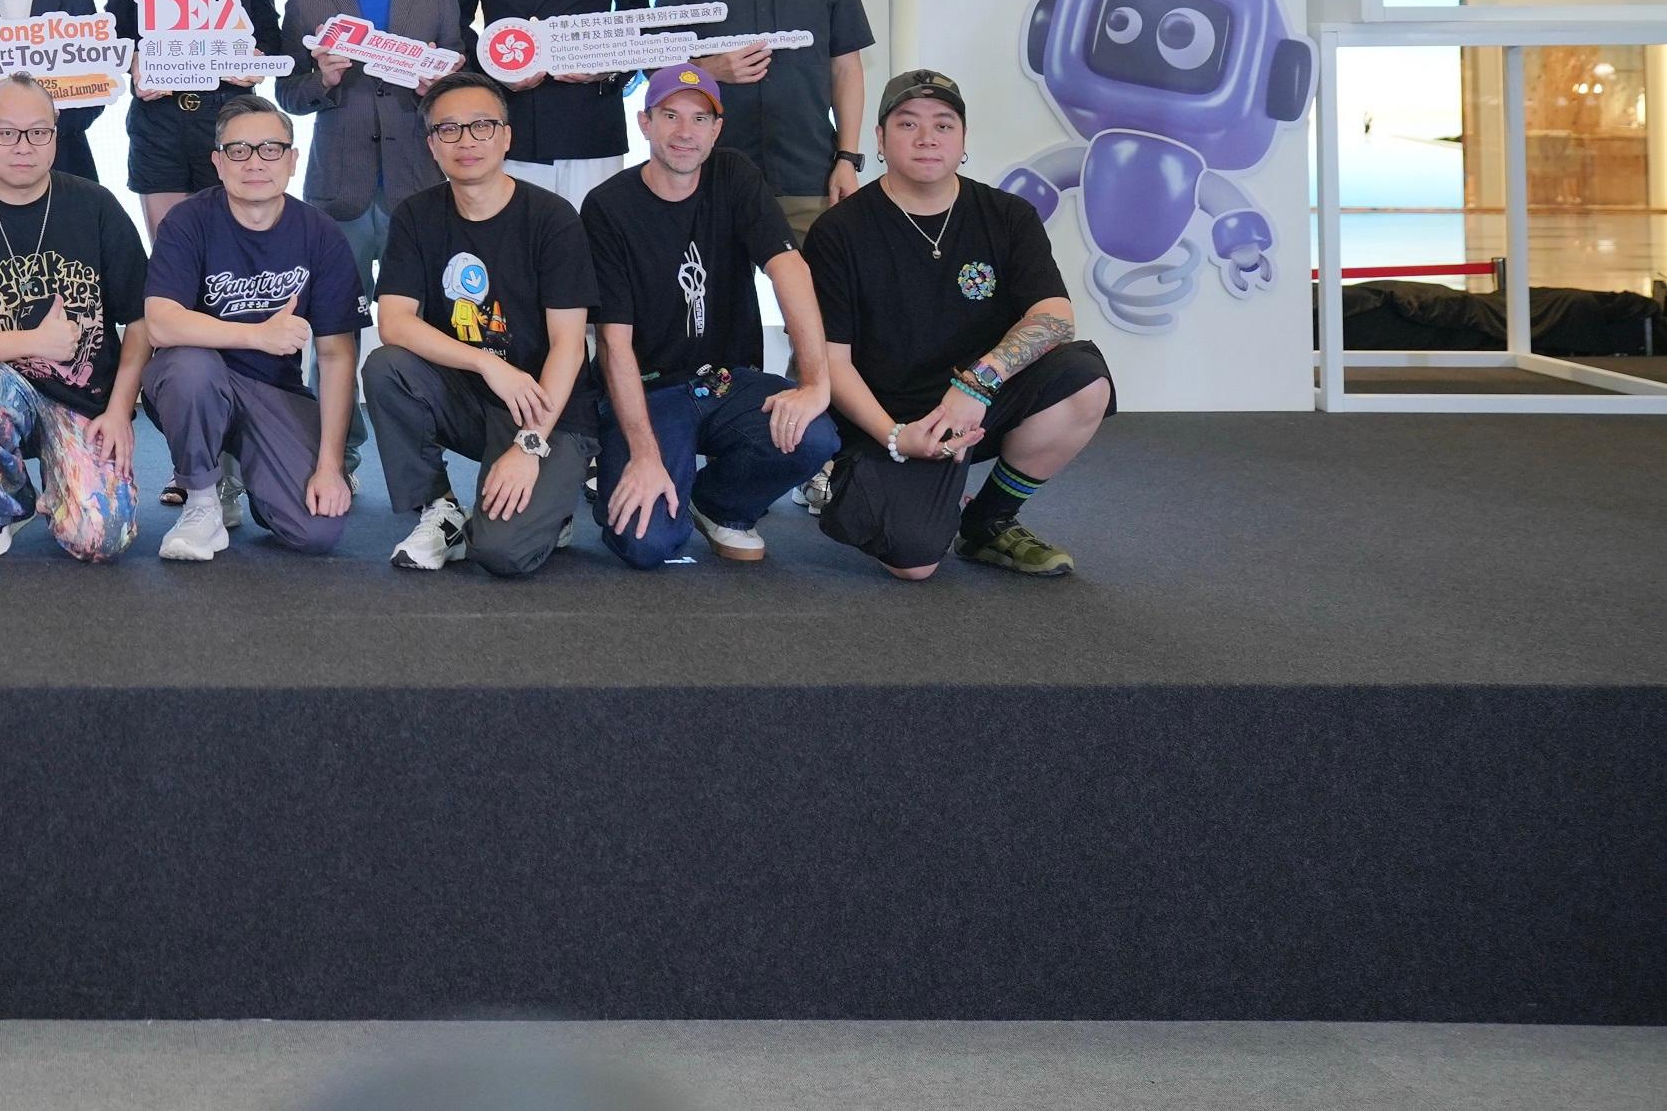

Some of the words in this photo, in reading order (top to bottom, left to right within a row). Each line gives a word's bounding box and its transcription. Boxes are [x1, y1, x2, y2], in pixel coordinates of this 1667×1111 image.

[549, 6, 722, 29] 中華人民共和國香港特別行政區政府
[48, 18, 110, 41] Kong
[550, 27, 636, 43] 文化體育及旅遊局
[145, 39, 249, 57] 創意創業會
[368, 35, 424, 58] 政府資助
[420, 56, 449, 72] 計劃
[550, 44, 581, 54] Culture,
[583, 42, 610, 52] Sports
[612, 41, 628, 49] and
[629, 38, 661, 47] Tourism
[664, 36, 692, 44] Bureau
[552, 54, 566, 62] The
[568, 51, 616, 62] Government
[618, 49, 627, 57] of
[628, 48, 641, 56] the
[642, 46, 664, 55] Hong
[666, 45, 686, 54] Kong
[688, 42, 719, 52] Special
[780, 34, 809, 44] Region
[16, 45, 58, 71] Toy
[62, 42, 127, 67] Story
[336, 43, 415, 69] Government-funded
[552, 63, 561, 71] of
[577, 60, 610, 70] People's
[612, 57, 647, 67] Republic
[649, 55, 658, 63] of
[659, 54, 682, 62] China
[145, 60, 206, 71] Innovative
[210, 59, 288, 73] Entrepreneur
[373, 62, 417, 77] programme
[145, 73, 213, 85] Association
[70, 82, 110, 97] Lumpur
[204, 265, 310, 306] Gangtiger
